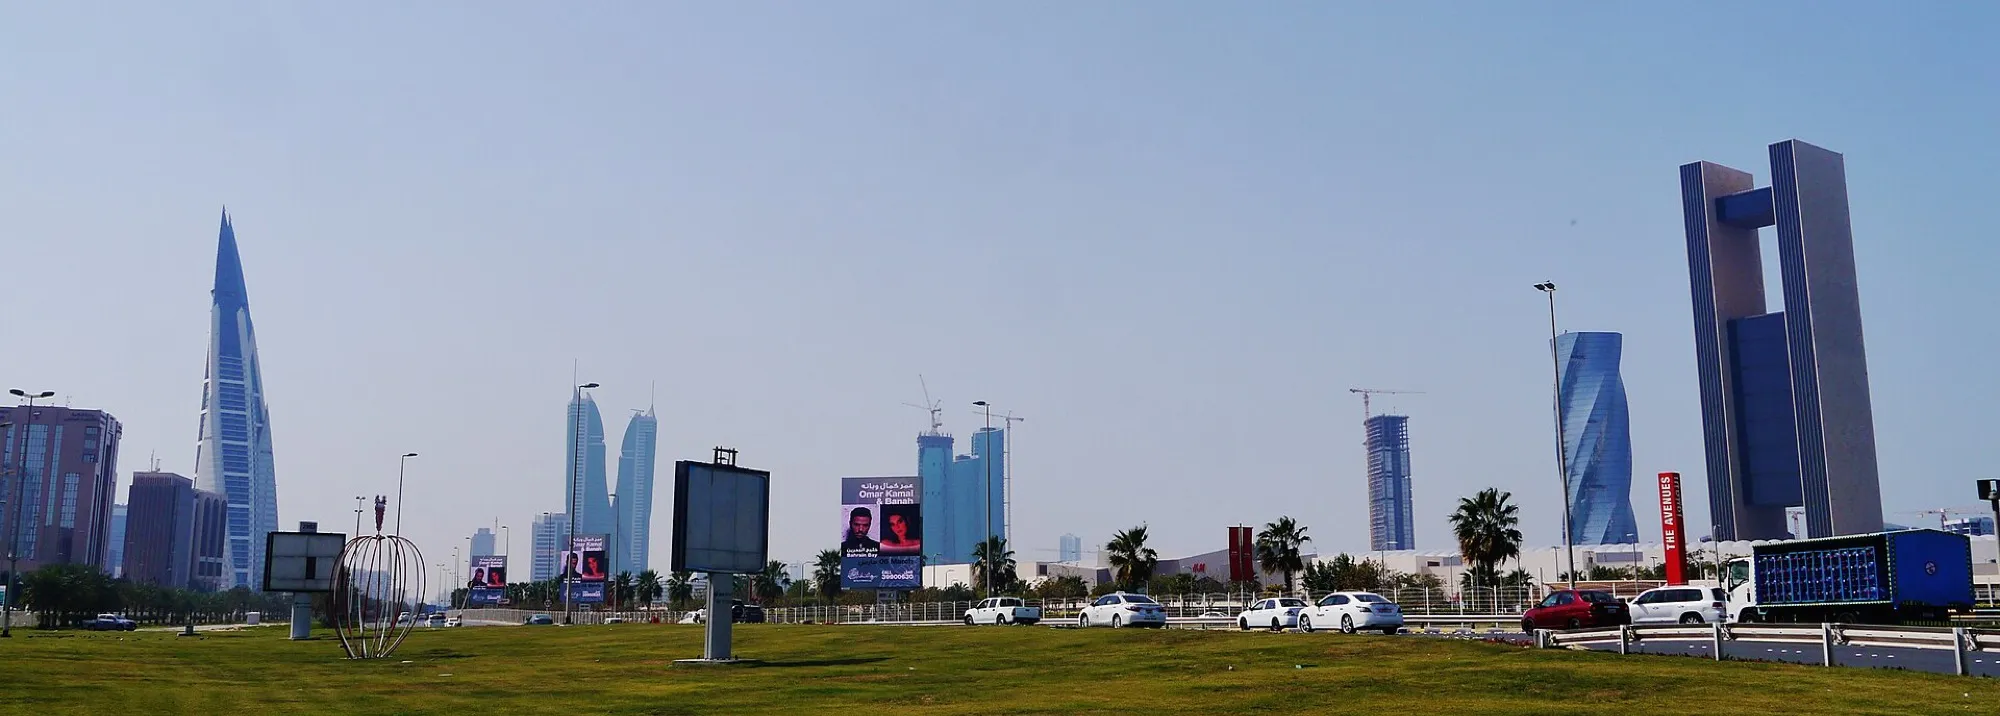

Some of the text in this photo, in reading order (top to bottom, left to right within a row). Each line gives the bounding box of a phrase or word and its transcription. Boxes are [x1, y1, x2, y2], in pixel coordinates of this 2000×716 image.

[859, 490, 884, 498] Omar
[1661, 476, 1676, 550] THE AVENUES
